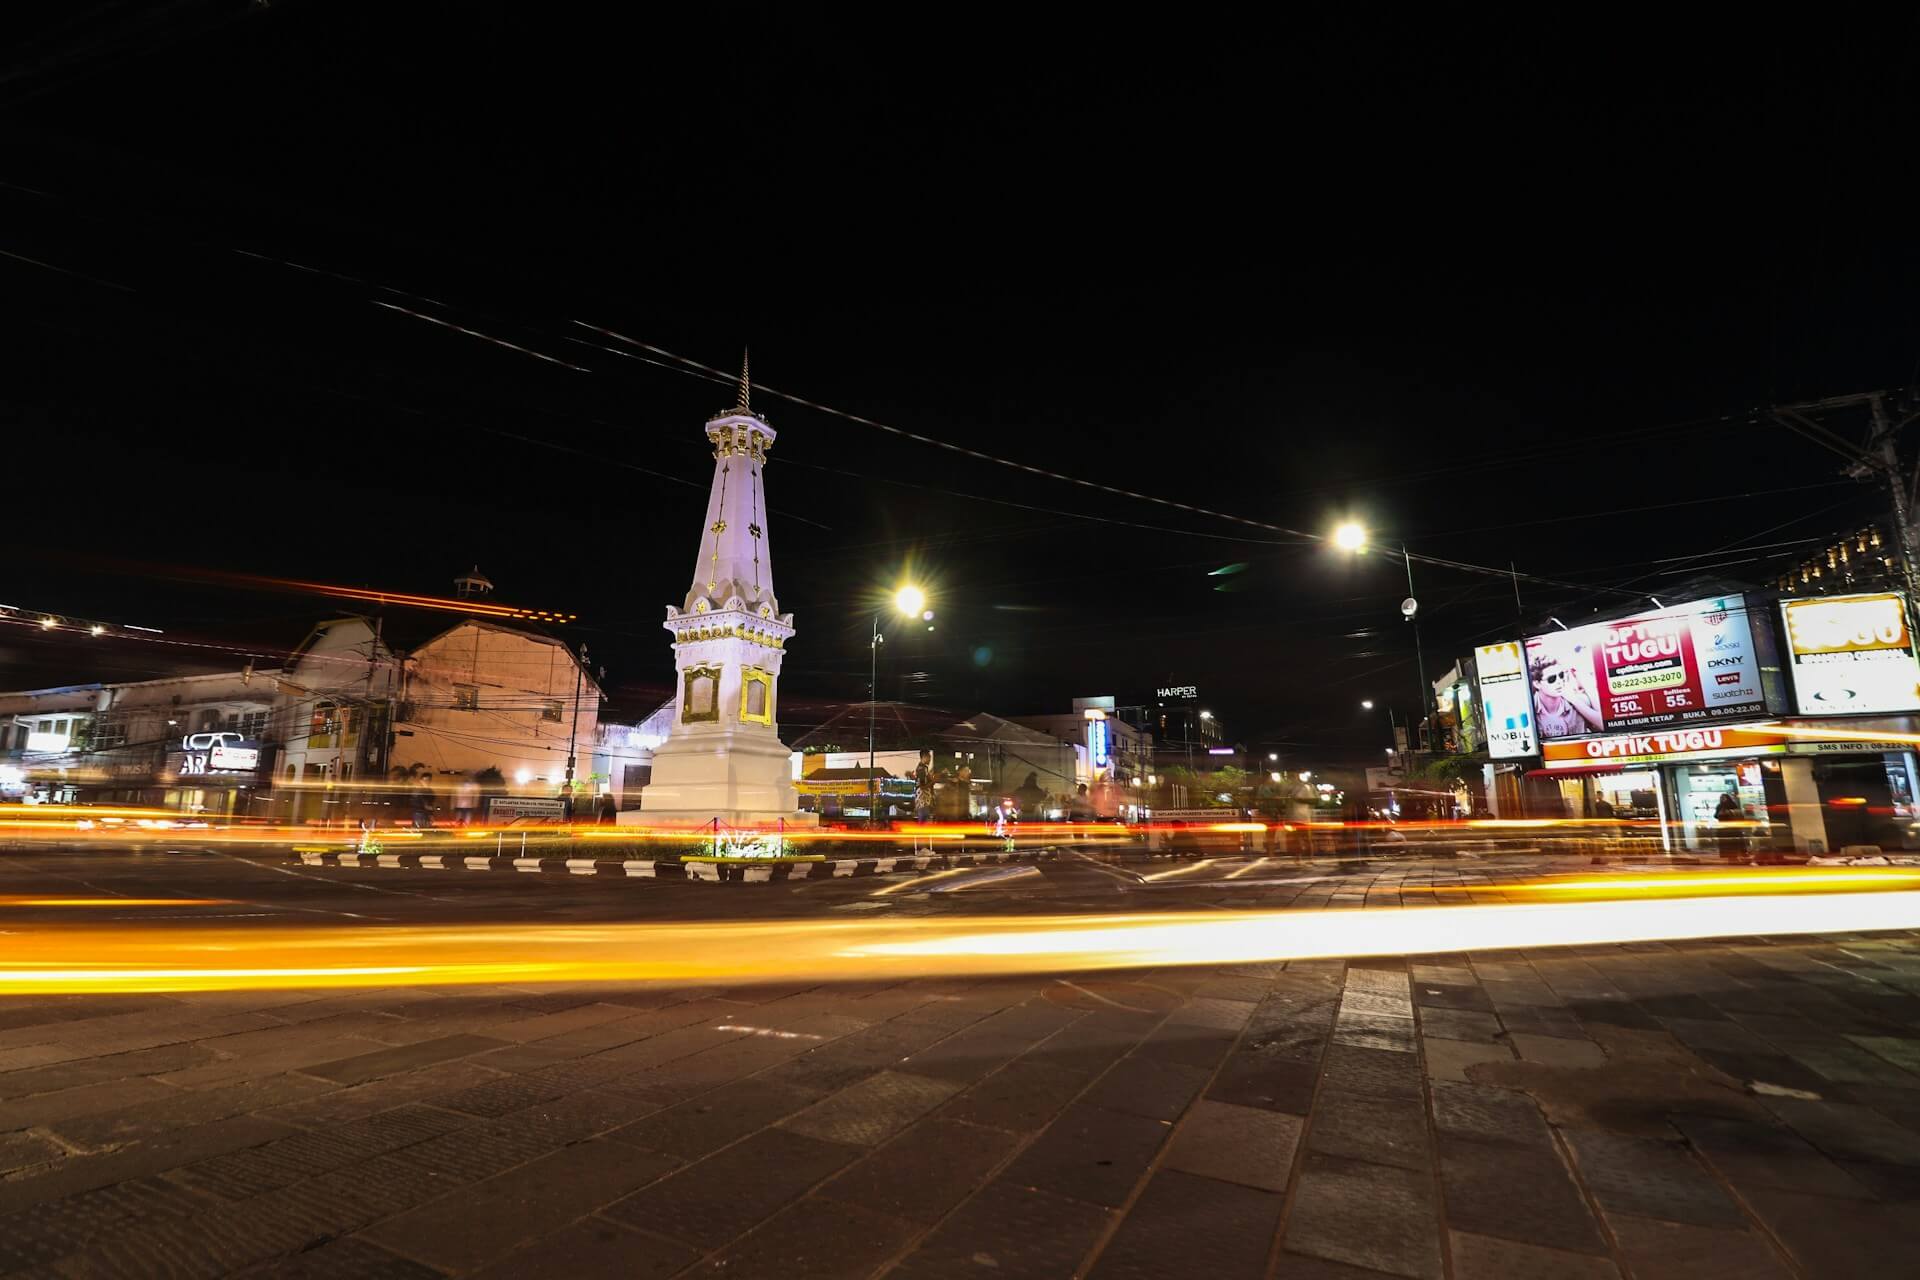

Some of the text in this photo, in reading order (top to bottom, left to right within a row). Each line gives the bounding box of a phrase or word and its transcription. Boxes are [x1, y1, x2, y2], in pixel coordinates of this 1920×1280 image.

[1606, 634, 1677, 664] TUGU
[1707, 656, 1743, 668] DKNY
[1612, 672, 1682, 689] 08-222-333-2070
[1157, 686, 1196, 697] HARPER
[1712, 689, 1746, 700] swatch
[1608, 719, 1625, 728] HARI
[1627, 717, 1650, 726] LIBUR
[1650, 714, 1674, 723] TETAP
[1682, 710, 1706, 719] BUKA
[1490, 731, 1530, 741] MOBIL
[1587, 730, 1722, 757] OPTIK TUGU
[1818, 743, 1838, 751] SMS
